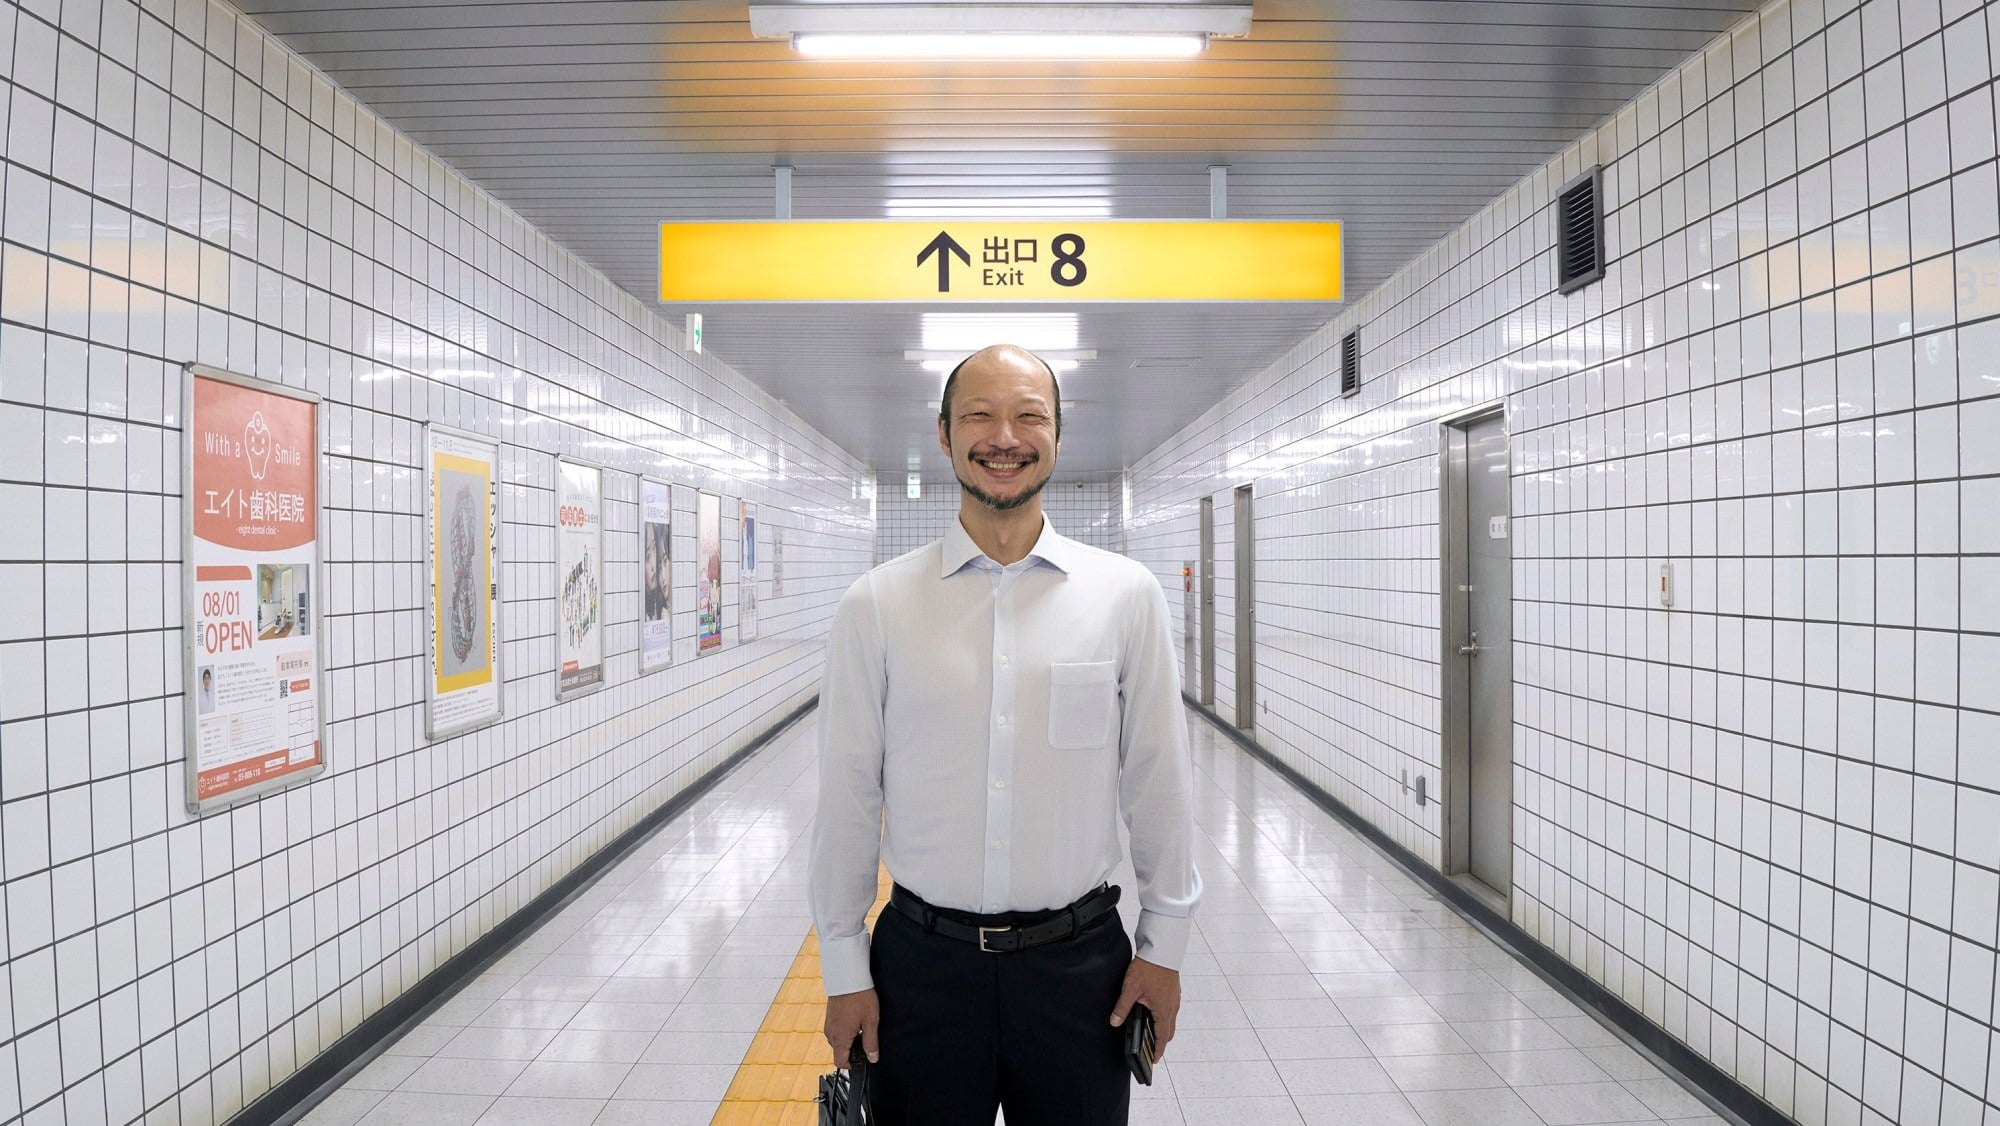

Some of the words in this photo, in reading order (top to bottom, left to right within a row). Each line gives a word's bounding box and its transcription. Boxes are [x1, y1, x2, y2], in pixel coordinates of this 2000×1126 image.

[983, 236, 1037, 264] 出口
[1051, 233, 1087, 287] 8
[983, 268, 1024, 286] Exit
[205, 432, 230, 456] With
[235, 441, 241, 458] a
[275, 443, 300, 465] Smile
[204, 489, 304, 522] エイト歯科医院
[203, 591, 240, 617] 08/01
[205, 620, 253, 655] OPEN
